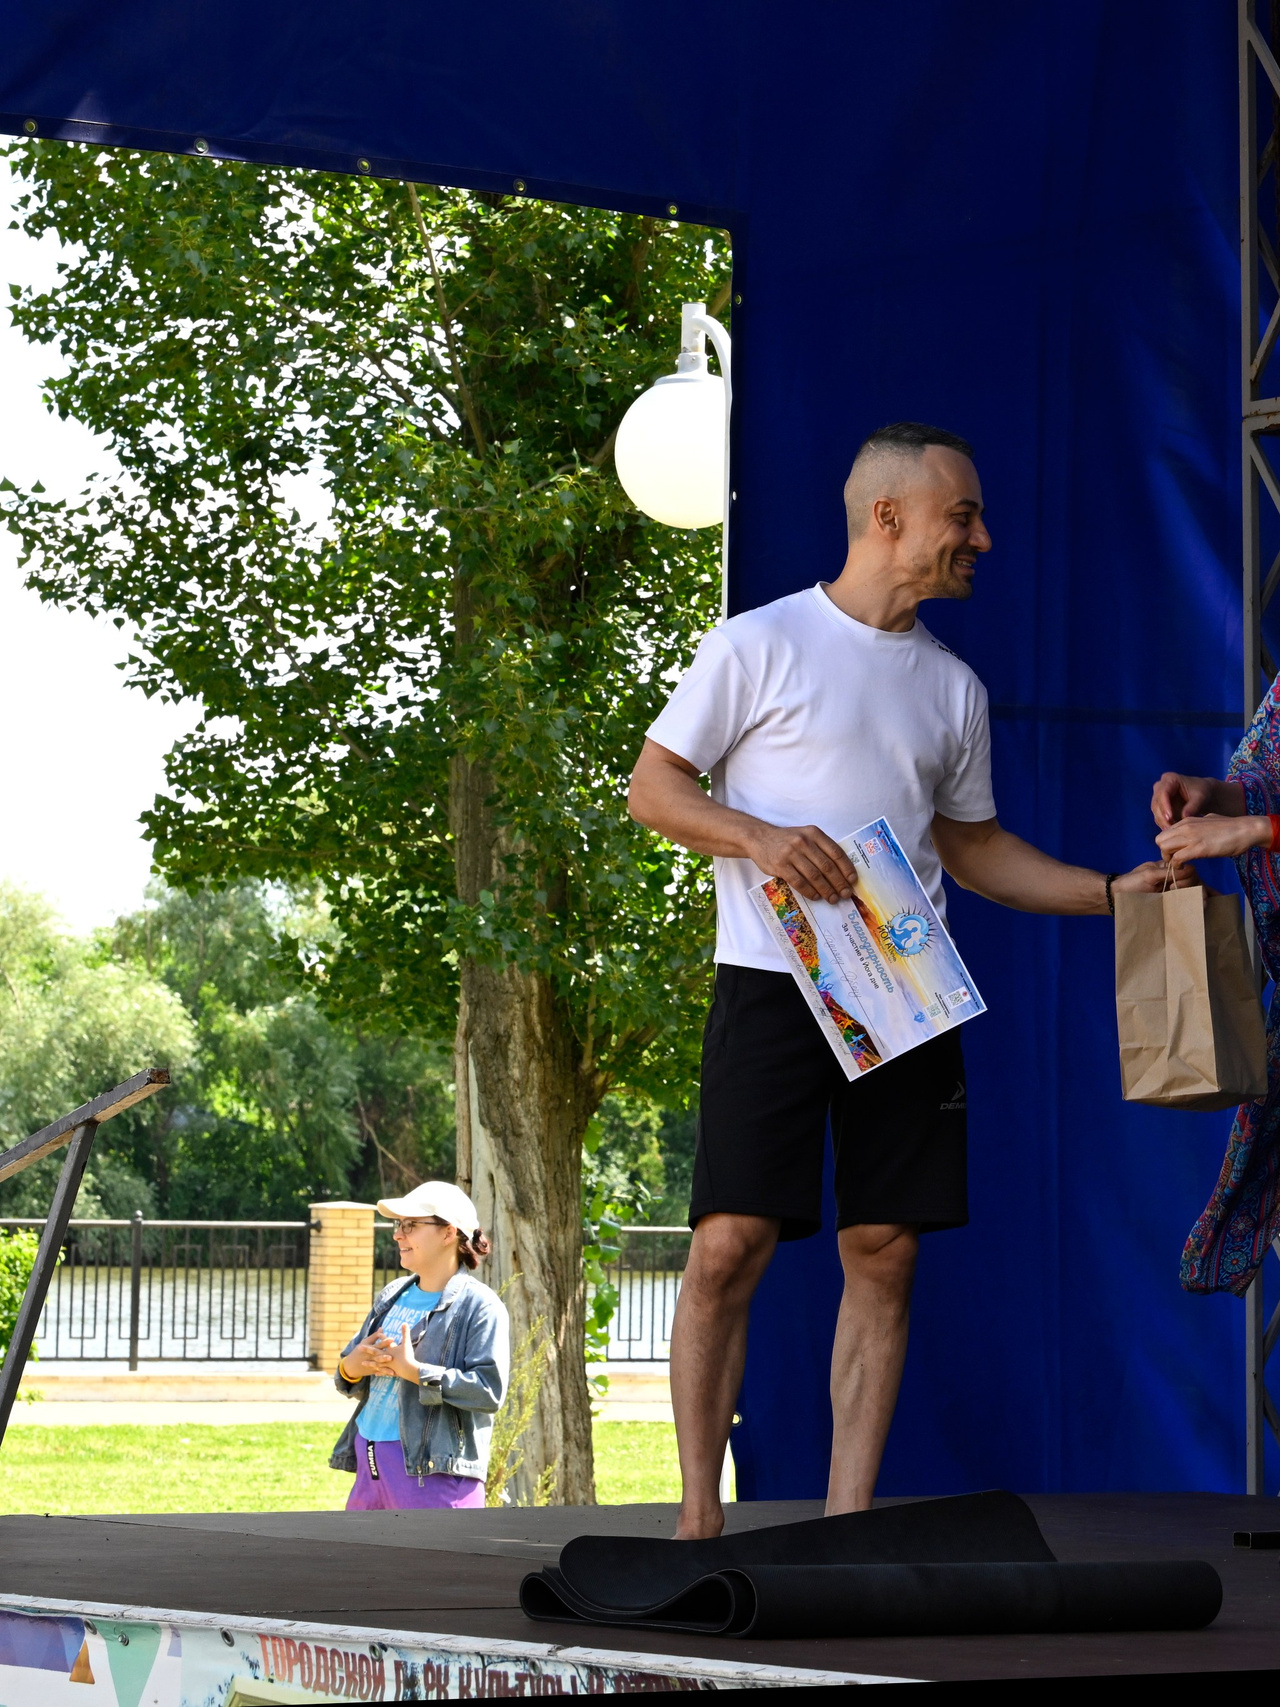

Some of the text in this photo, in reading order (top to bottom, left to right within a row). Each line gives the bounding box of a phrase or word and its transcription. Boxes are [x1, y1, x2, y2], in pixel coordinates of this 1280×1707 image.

[840, 922, 850, 932] За
[844, 931, 863, 957] участие
[846, 908, 895, 994] Благодарность
[861, 960, 874, 977] Йога
[869, 976, 880, 990] дне
[387, 1304, 421, 1322] DANCE
[367, 1445, 378, 1476] ZUMBA
[257, 1632, 386, 1701] ГОРОДСКОЙ
[394, 1659, 450, 1701] ПРК
